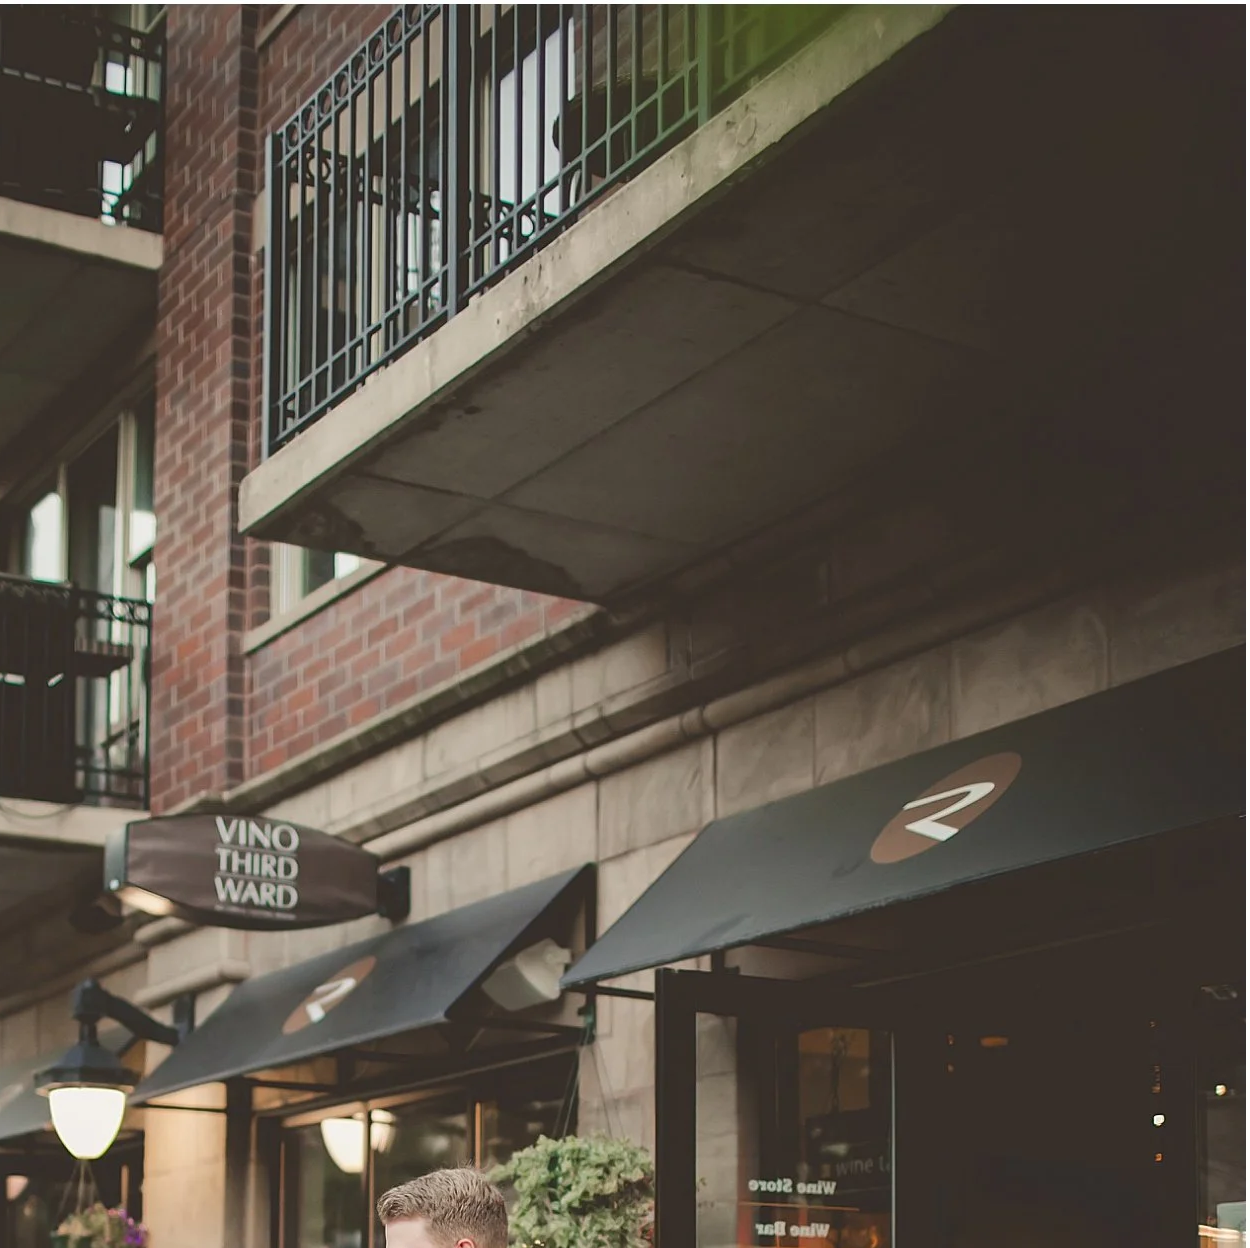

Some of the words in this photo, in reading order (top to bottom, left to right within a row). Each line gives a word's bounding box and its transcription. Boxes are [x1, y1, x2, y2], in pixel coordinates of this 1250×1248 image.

[215, 815, 299, 852] VINO
[215, 847, 299, 880] THIRD
[214, 876, 299, 909] WARD
